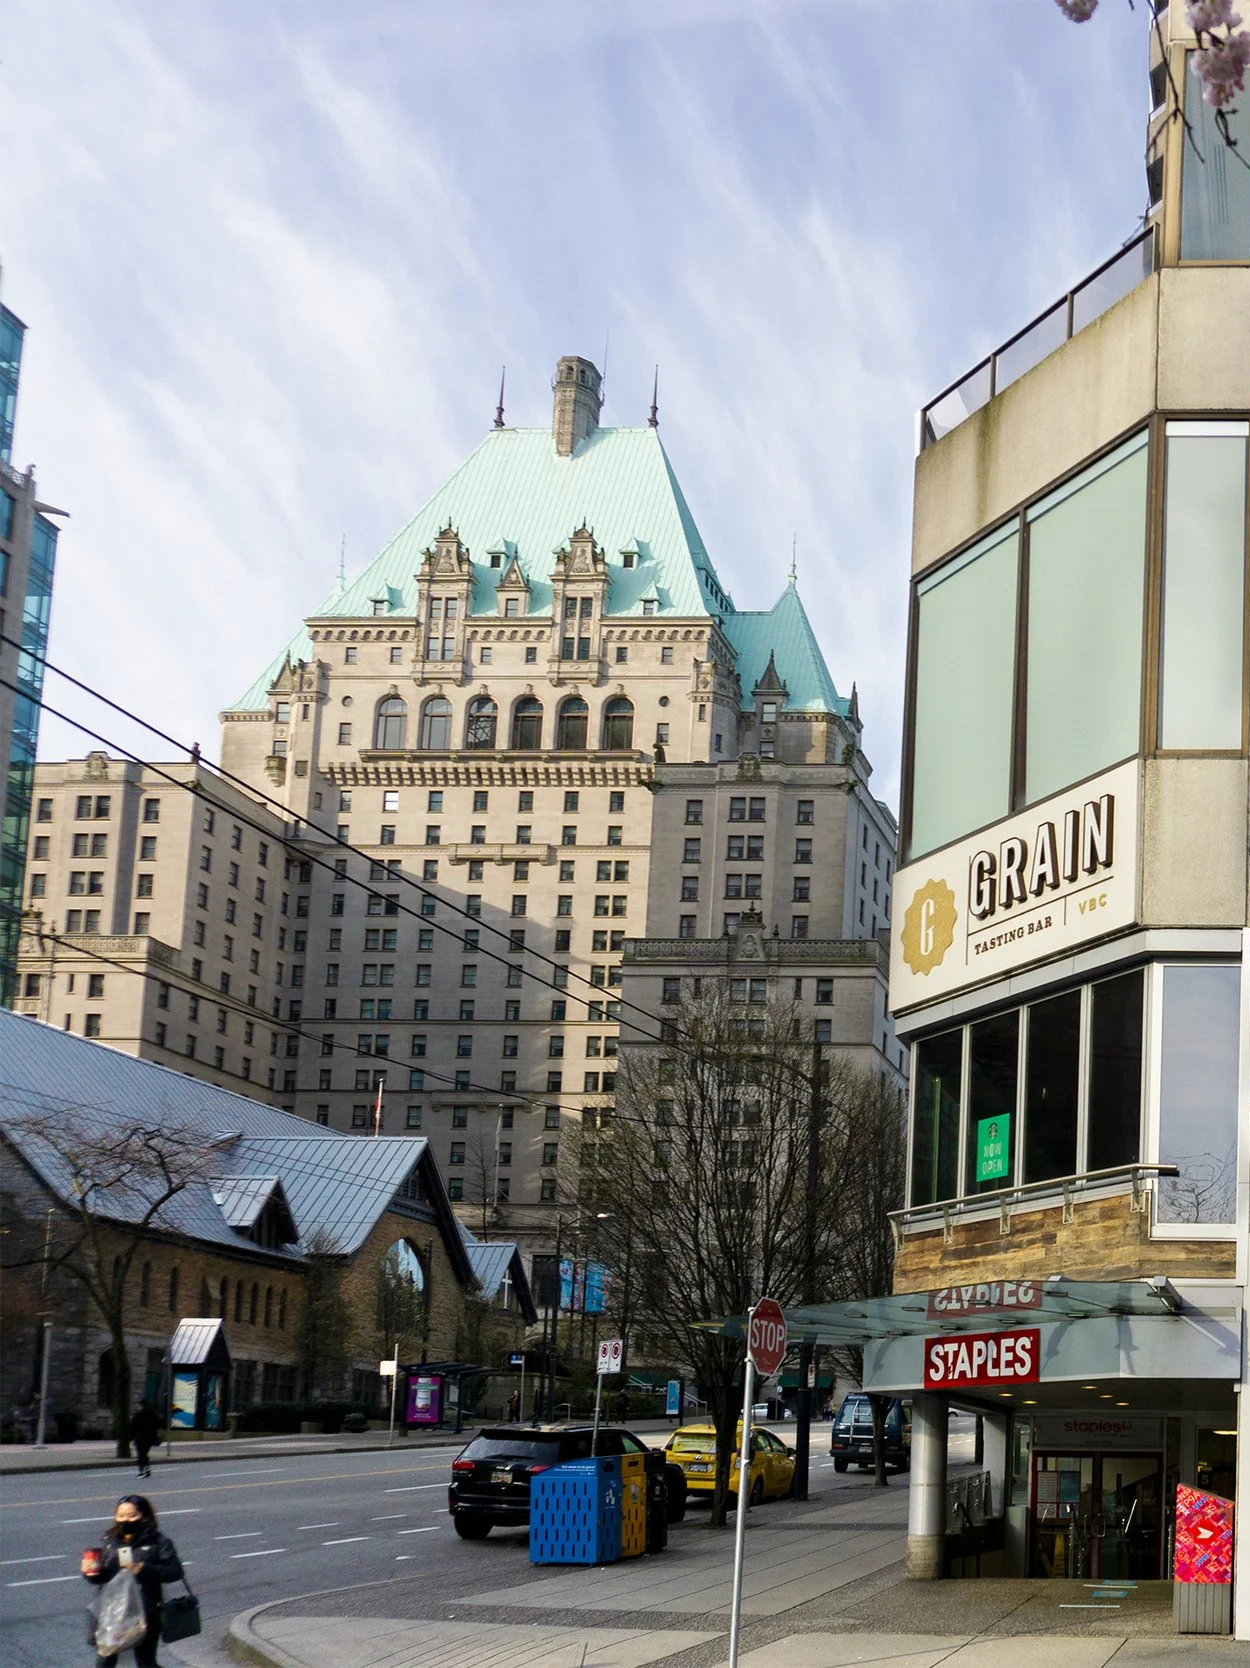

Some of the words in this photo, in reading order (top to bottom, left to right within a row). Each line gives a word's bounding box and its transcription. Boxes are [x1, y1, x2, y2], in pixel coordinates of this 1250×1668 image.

[969, 793, 1115, 920] GRAIN
[1078, 893, 1108, 915] VBC
[974, 929, 1024, 955] TASTING
[1027, 915, 1053, 936] BAR
[984, 1142, 1002, 1157] NOW
[982, 1159, 1002, 1175] OPEN
[751, 1318, 784, 1353] STOP
[929, 1336, 1033, 1381] STAPLES
[1063, 1420, 1122, 1434] staples
